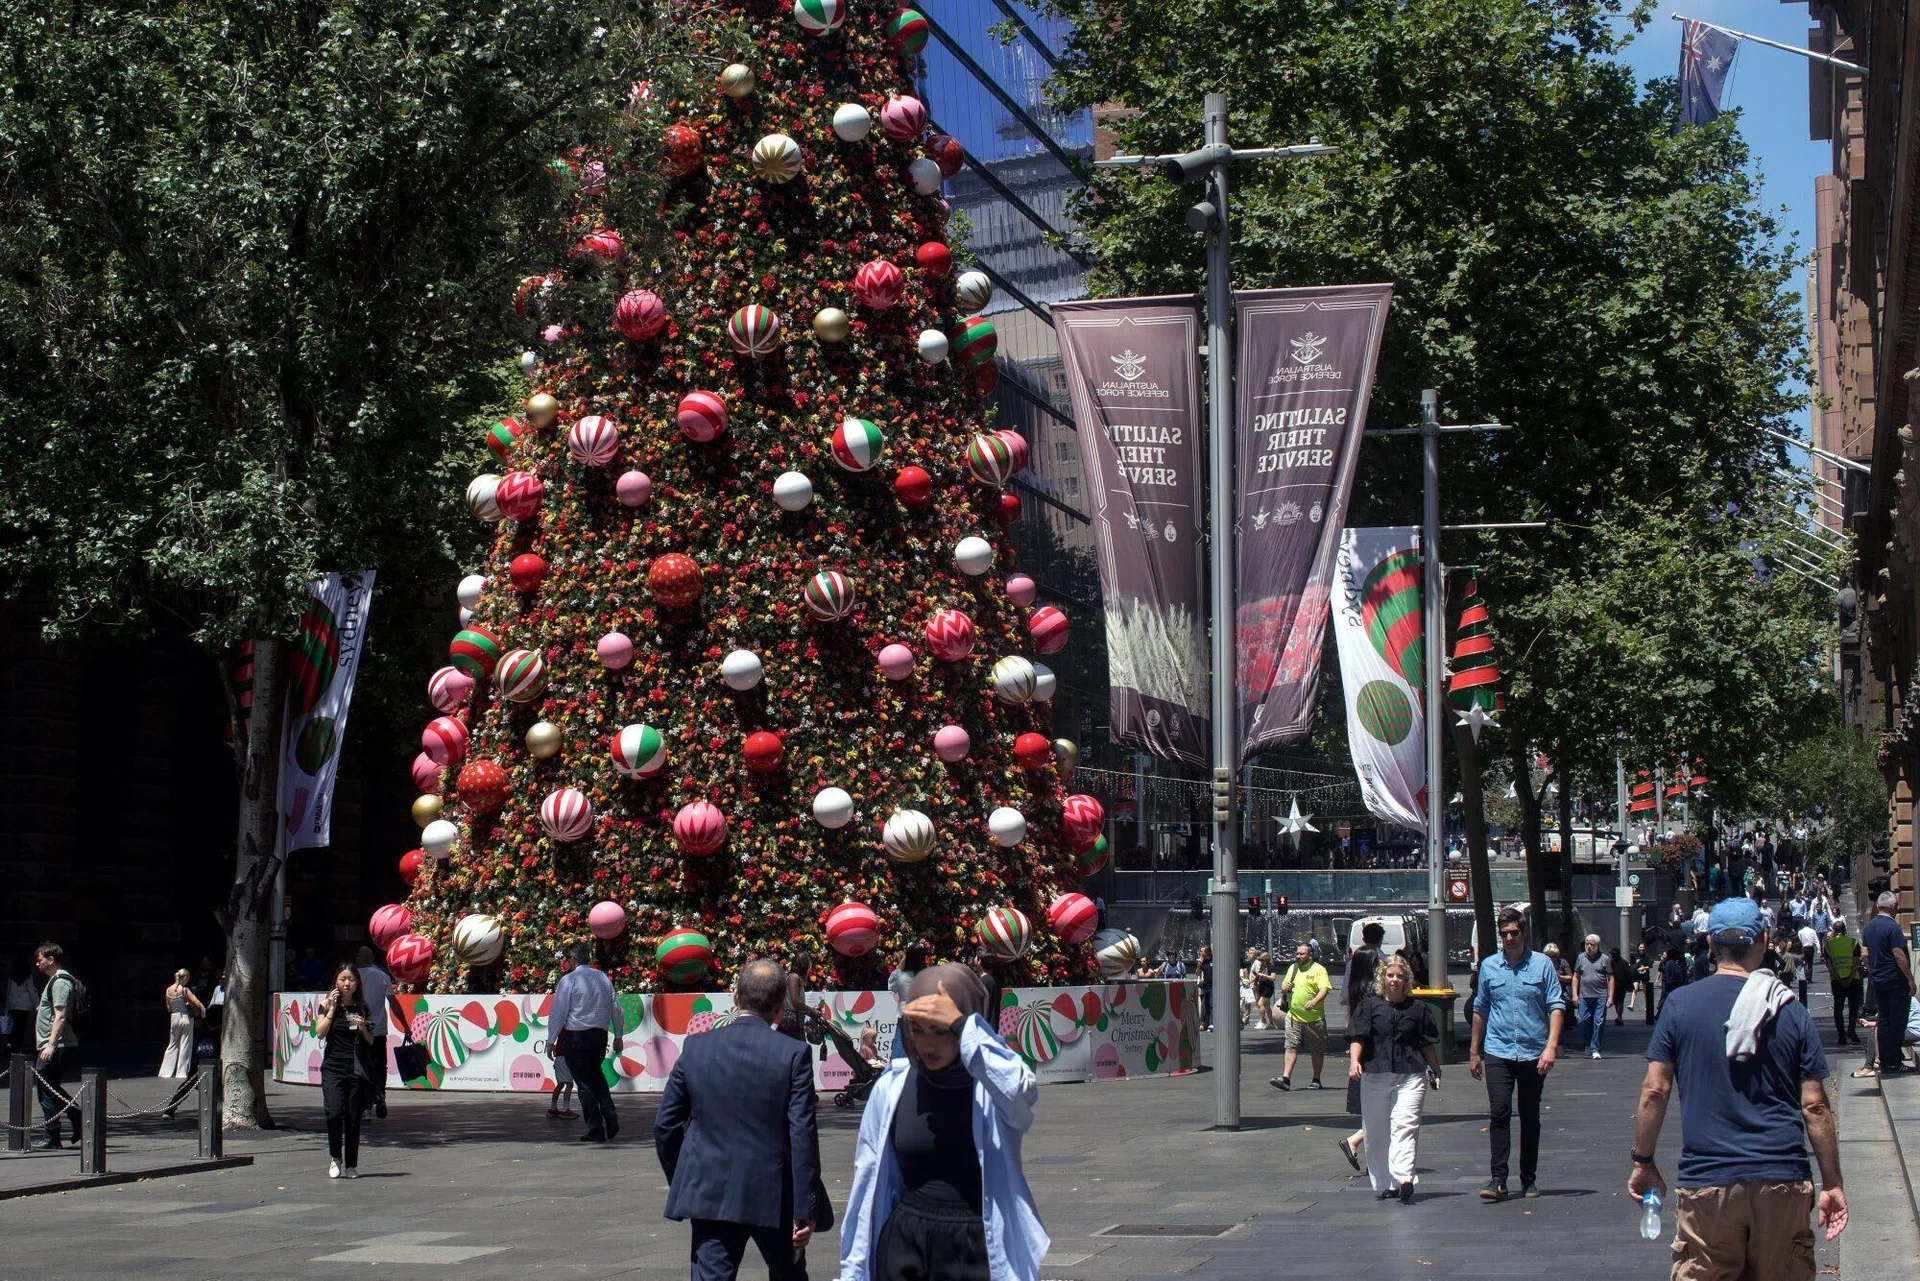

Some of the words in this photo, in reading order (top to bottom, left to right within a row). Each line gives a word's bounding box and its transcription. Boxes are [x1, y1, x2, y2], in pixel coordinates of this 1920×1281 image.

[338, 585, 366, 668] sydney
[865, 1020, 897, 1033] Mer
[1121, 1012, 1146, 1027] Merry
[1111, 1027, 1154, 1043] Christmas
